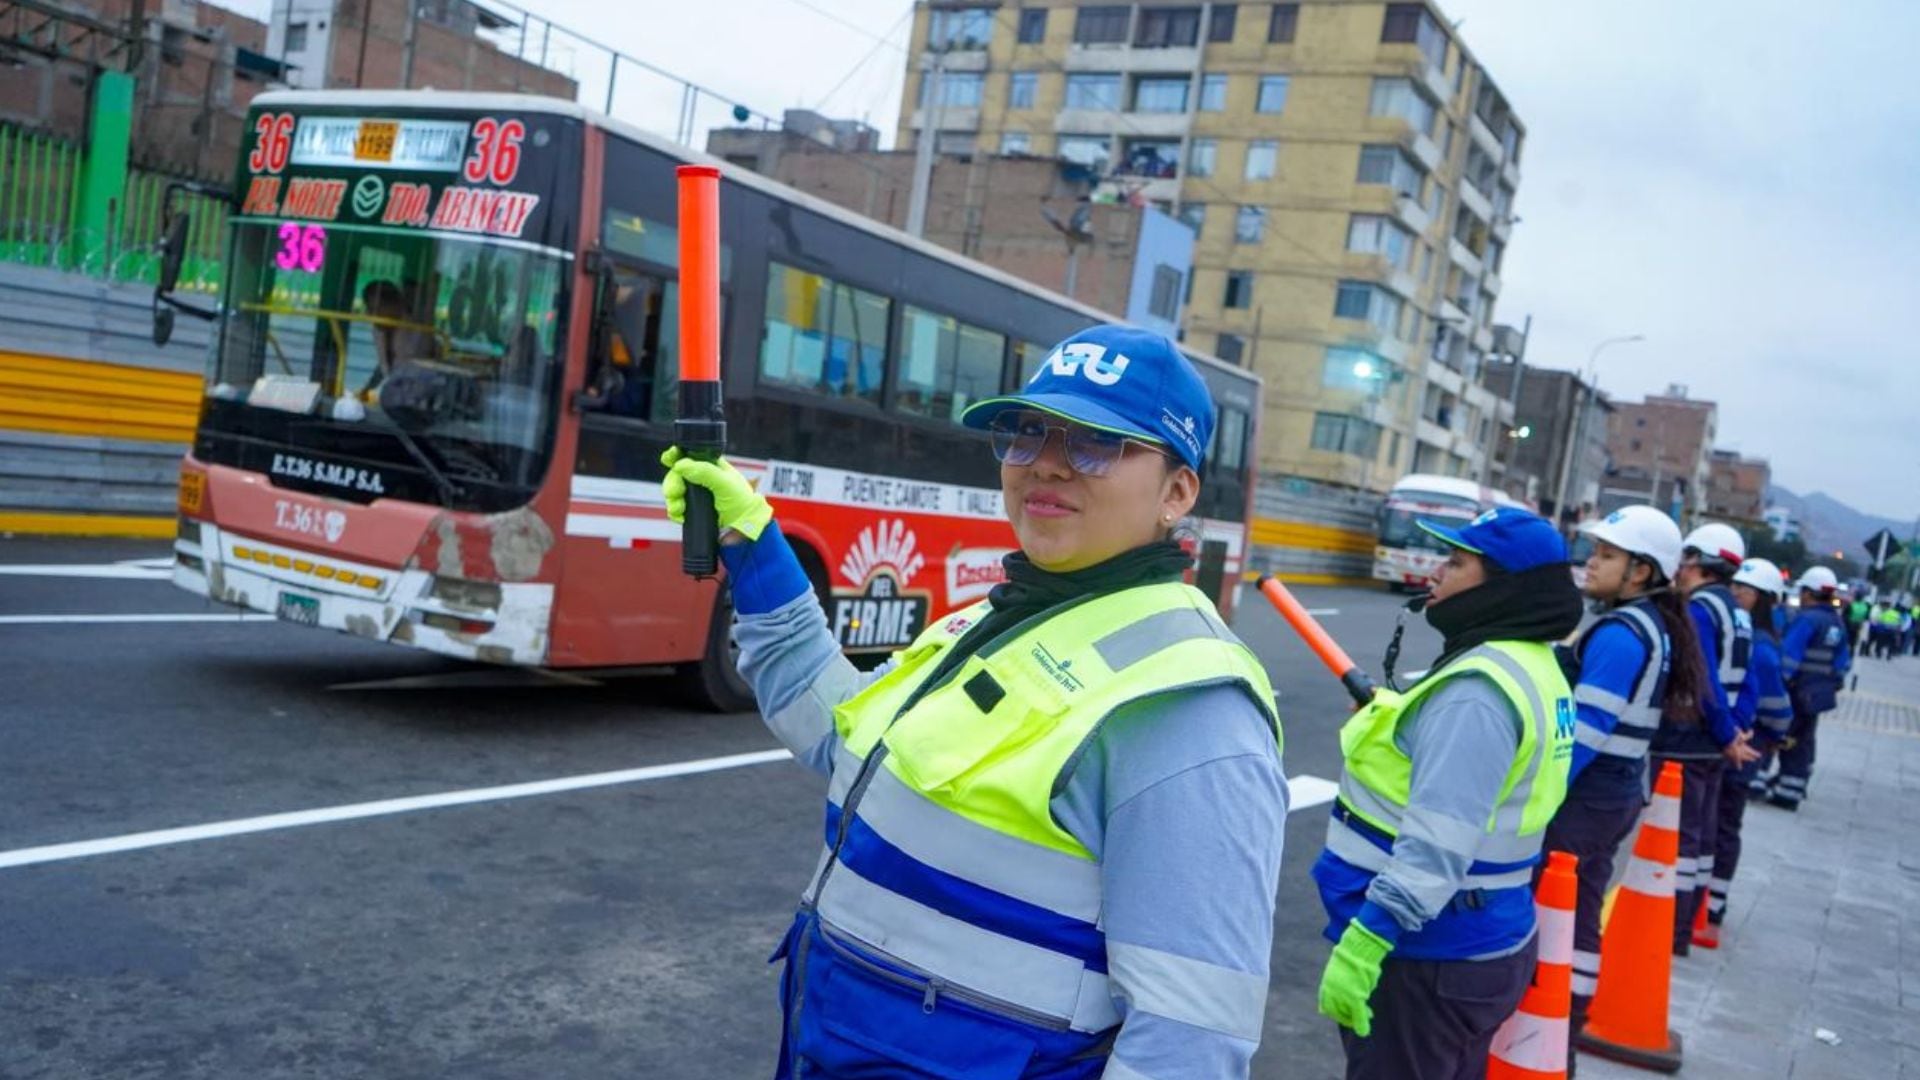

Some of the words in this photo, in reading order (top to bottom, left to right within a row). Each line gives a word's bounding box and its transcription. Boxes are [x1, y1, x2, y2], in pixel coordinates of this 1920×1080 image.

[249, 112, 295, 173] 36
[465, 117, 525, 185] 36
[281, 177, 348, 221] NORTE
[428, 186, 540, 238] ABANCAY
[276, 221, 326, 272] 36
[842, 475, 892, 506] PUENTE
[840, 518, 926, 588] VINAGRE
[833, 600, 917, 645] FIRME
